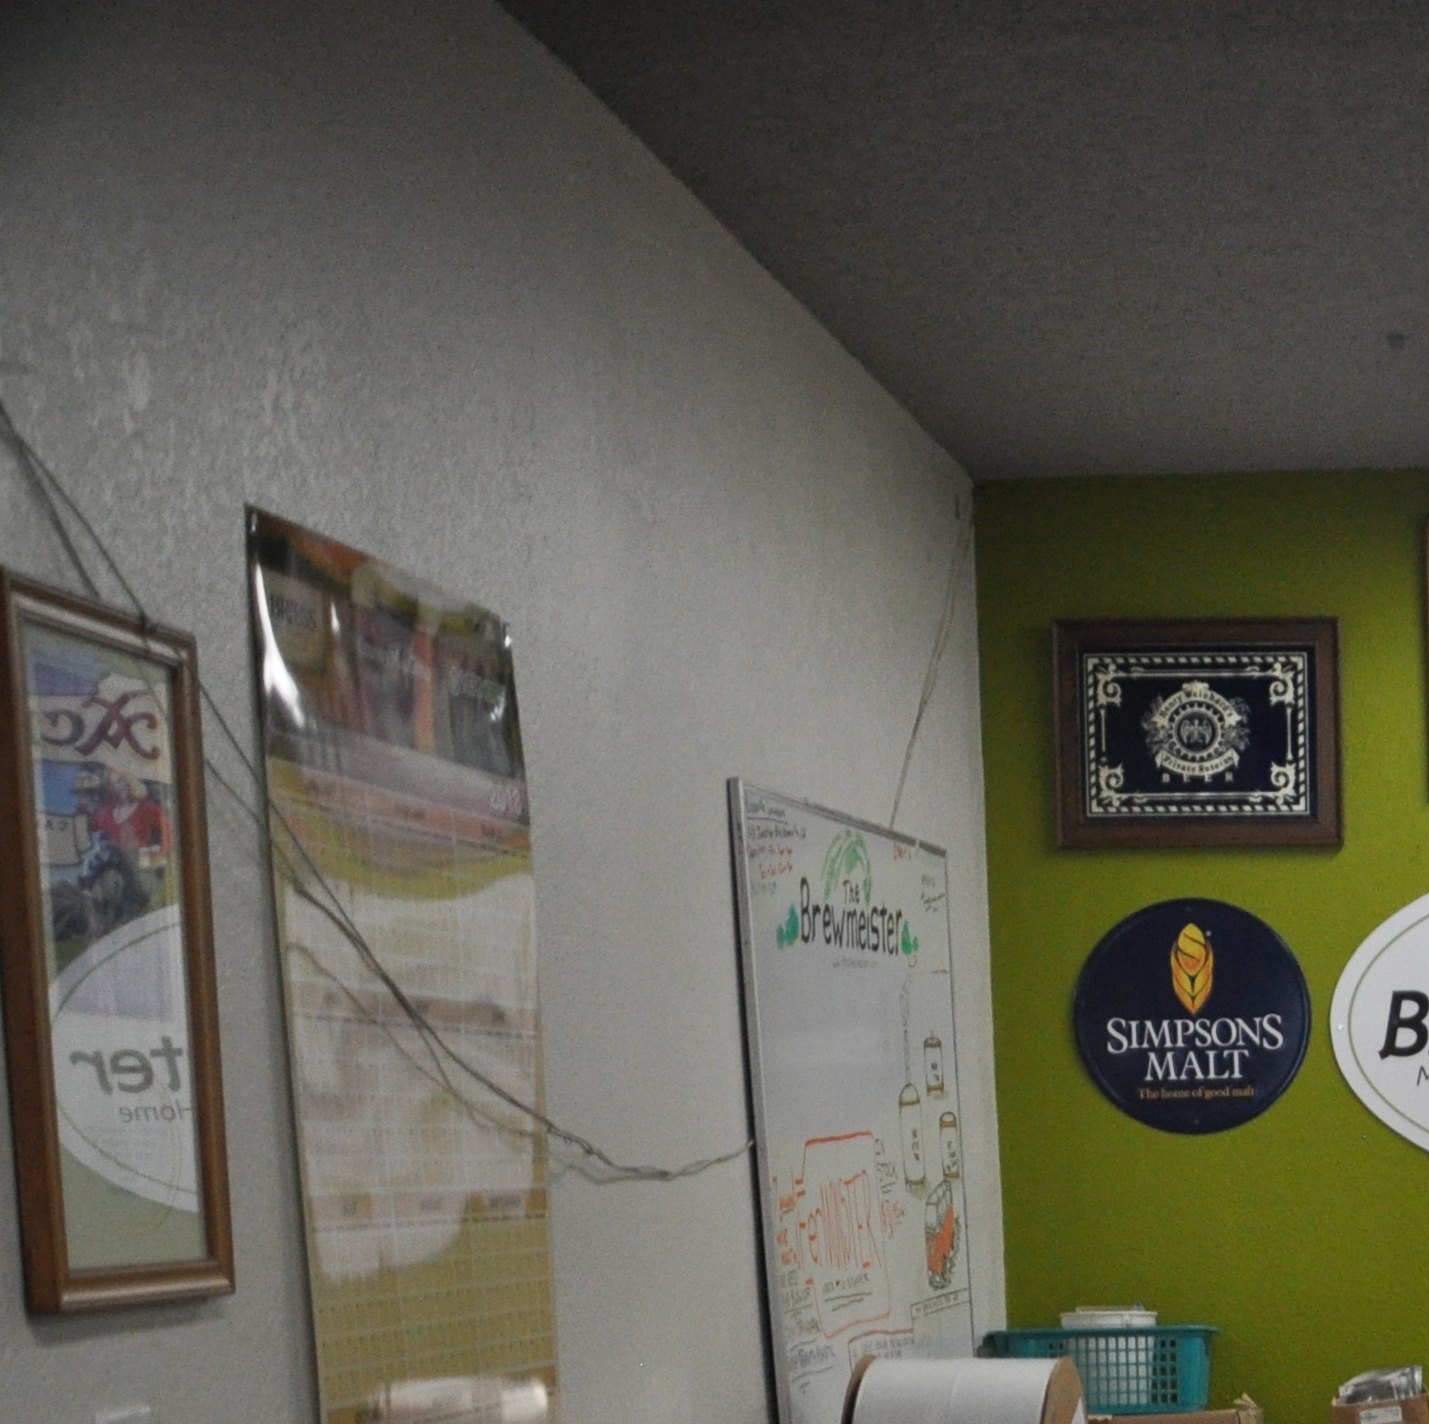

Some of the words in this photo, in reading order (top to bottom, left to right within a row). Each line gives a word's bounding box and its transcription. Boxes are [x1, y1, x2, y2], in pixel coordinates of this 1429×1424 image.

[842, 878, 860, 905] The
[799, 876, 903, 957] Brewmeister
[1106, 1013, 1285, 1055] SIMPSONS
[1144, 1049, 1250, 1082] MALT
[1138, 1087, 1159, 1100] The
[1161, 1086, 1190, 1100] home
[1192, 1086, 1204, 1099] of
[1204, 1085, 1231, 1101] good
[1232, 1084, 1255, 1098] malt
